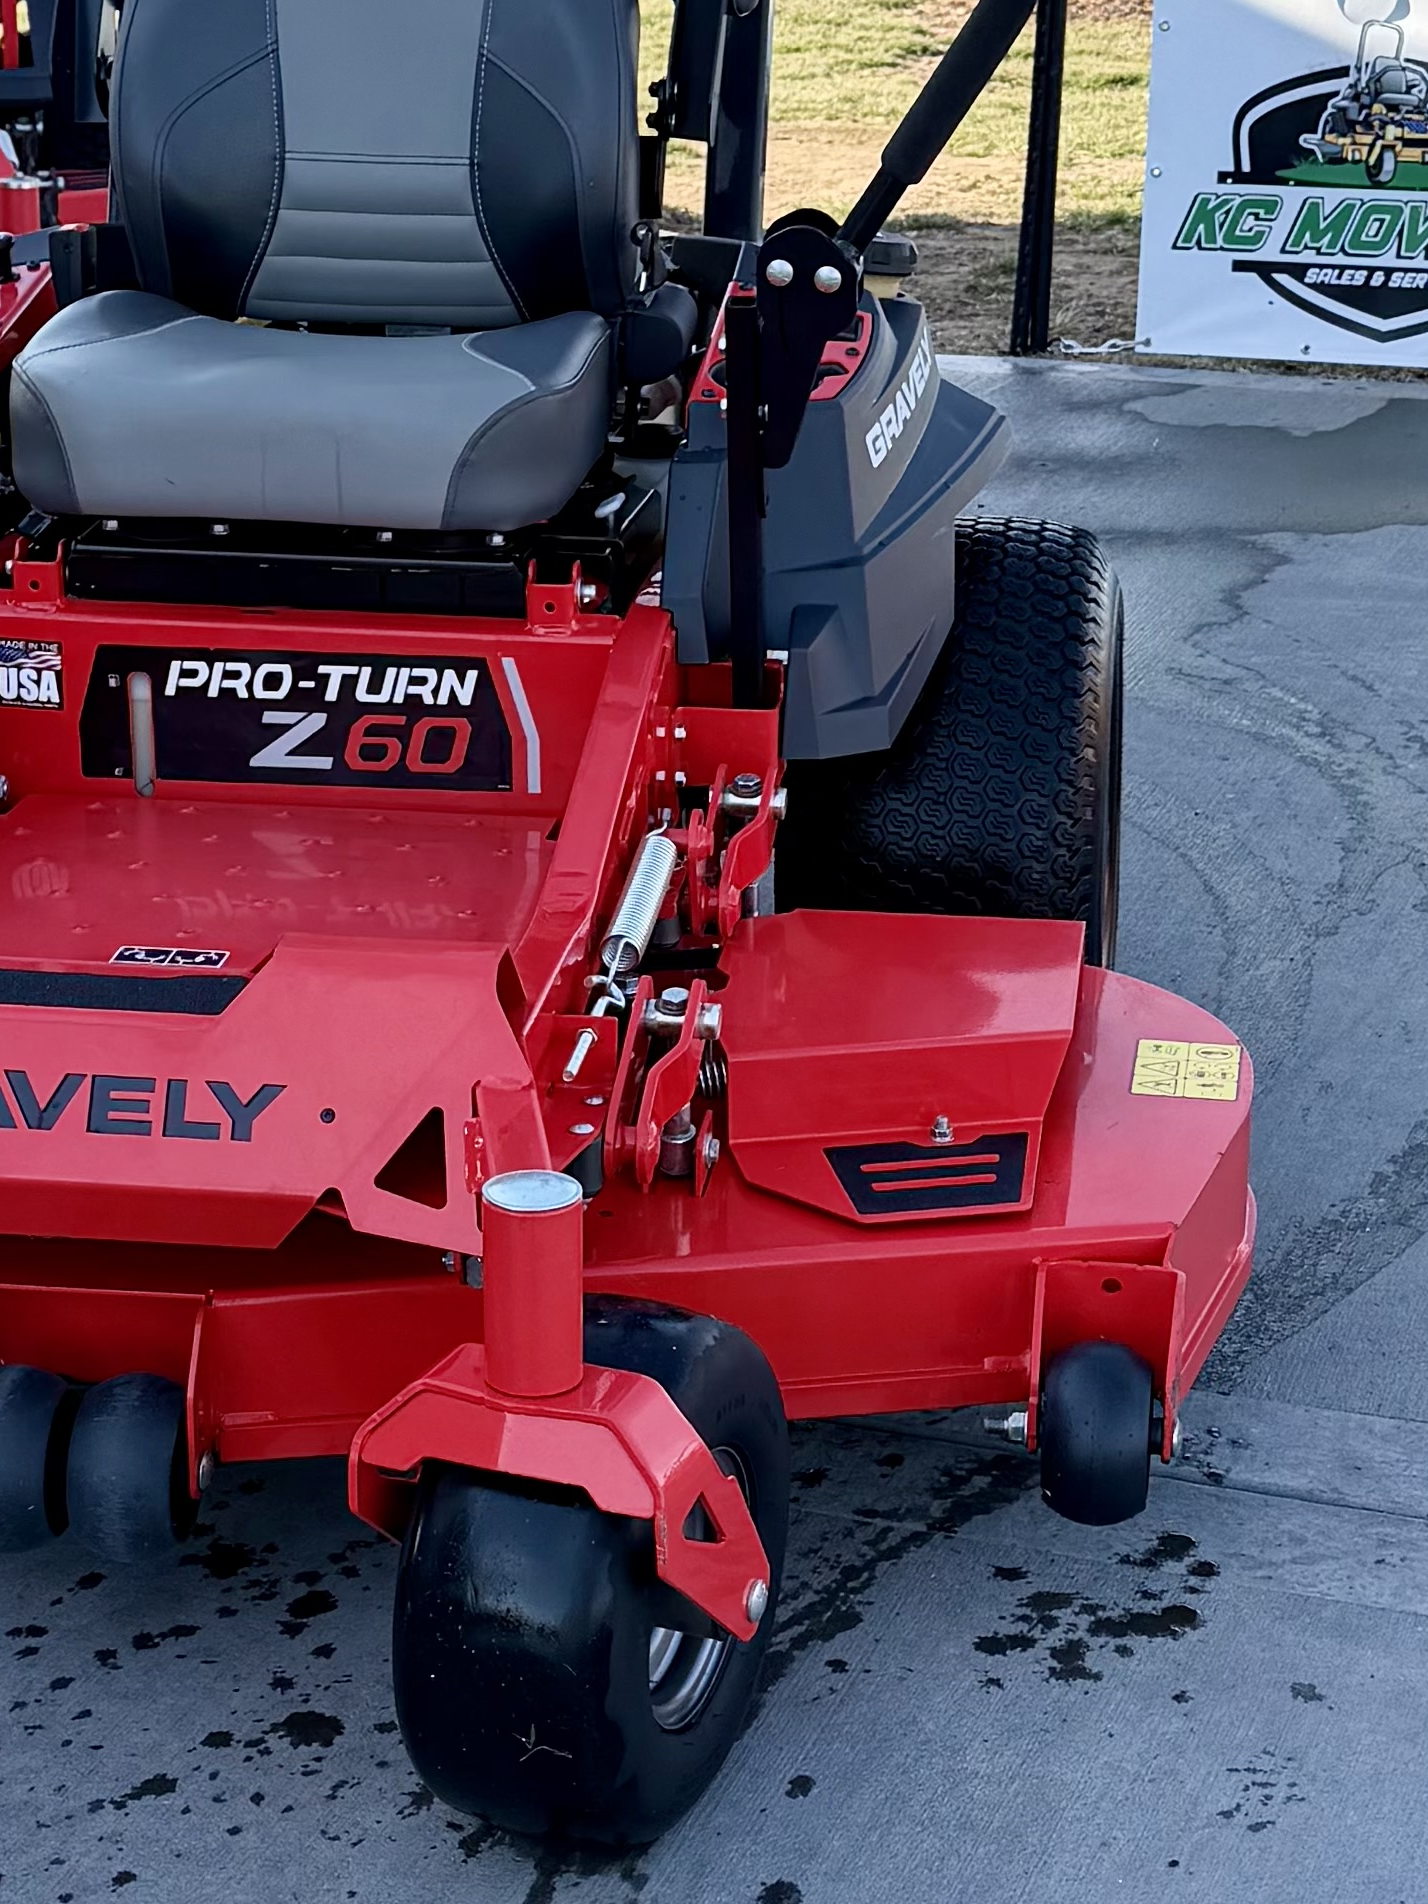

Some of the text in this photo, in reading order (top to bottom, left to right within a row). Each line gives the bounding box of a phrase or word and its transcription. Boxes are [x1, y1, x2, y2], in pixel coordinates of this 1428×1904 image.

[1172, 192, 1283, 251] KC
[1303, 267, 1368, 287] SALES
[865, 326, 932, 469] GRAVELY
[28, 642, 39, 651] IN
[40, 643, 59, 654] THE
[164, 660, 479, 706] PRO-TURN
